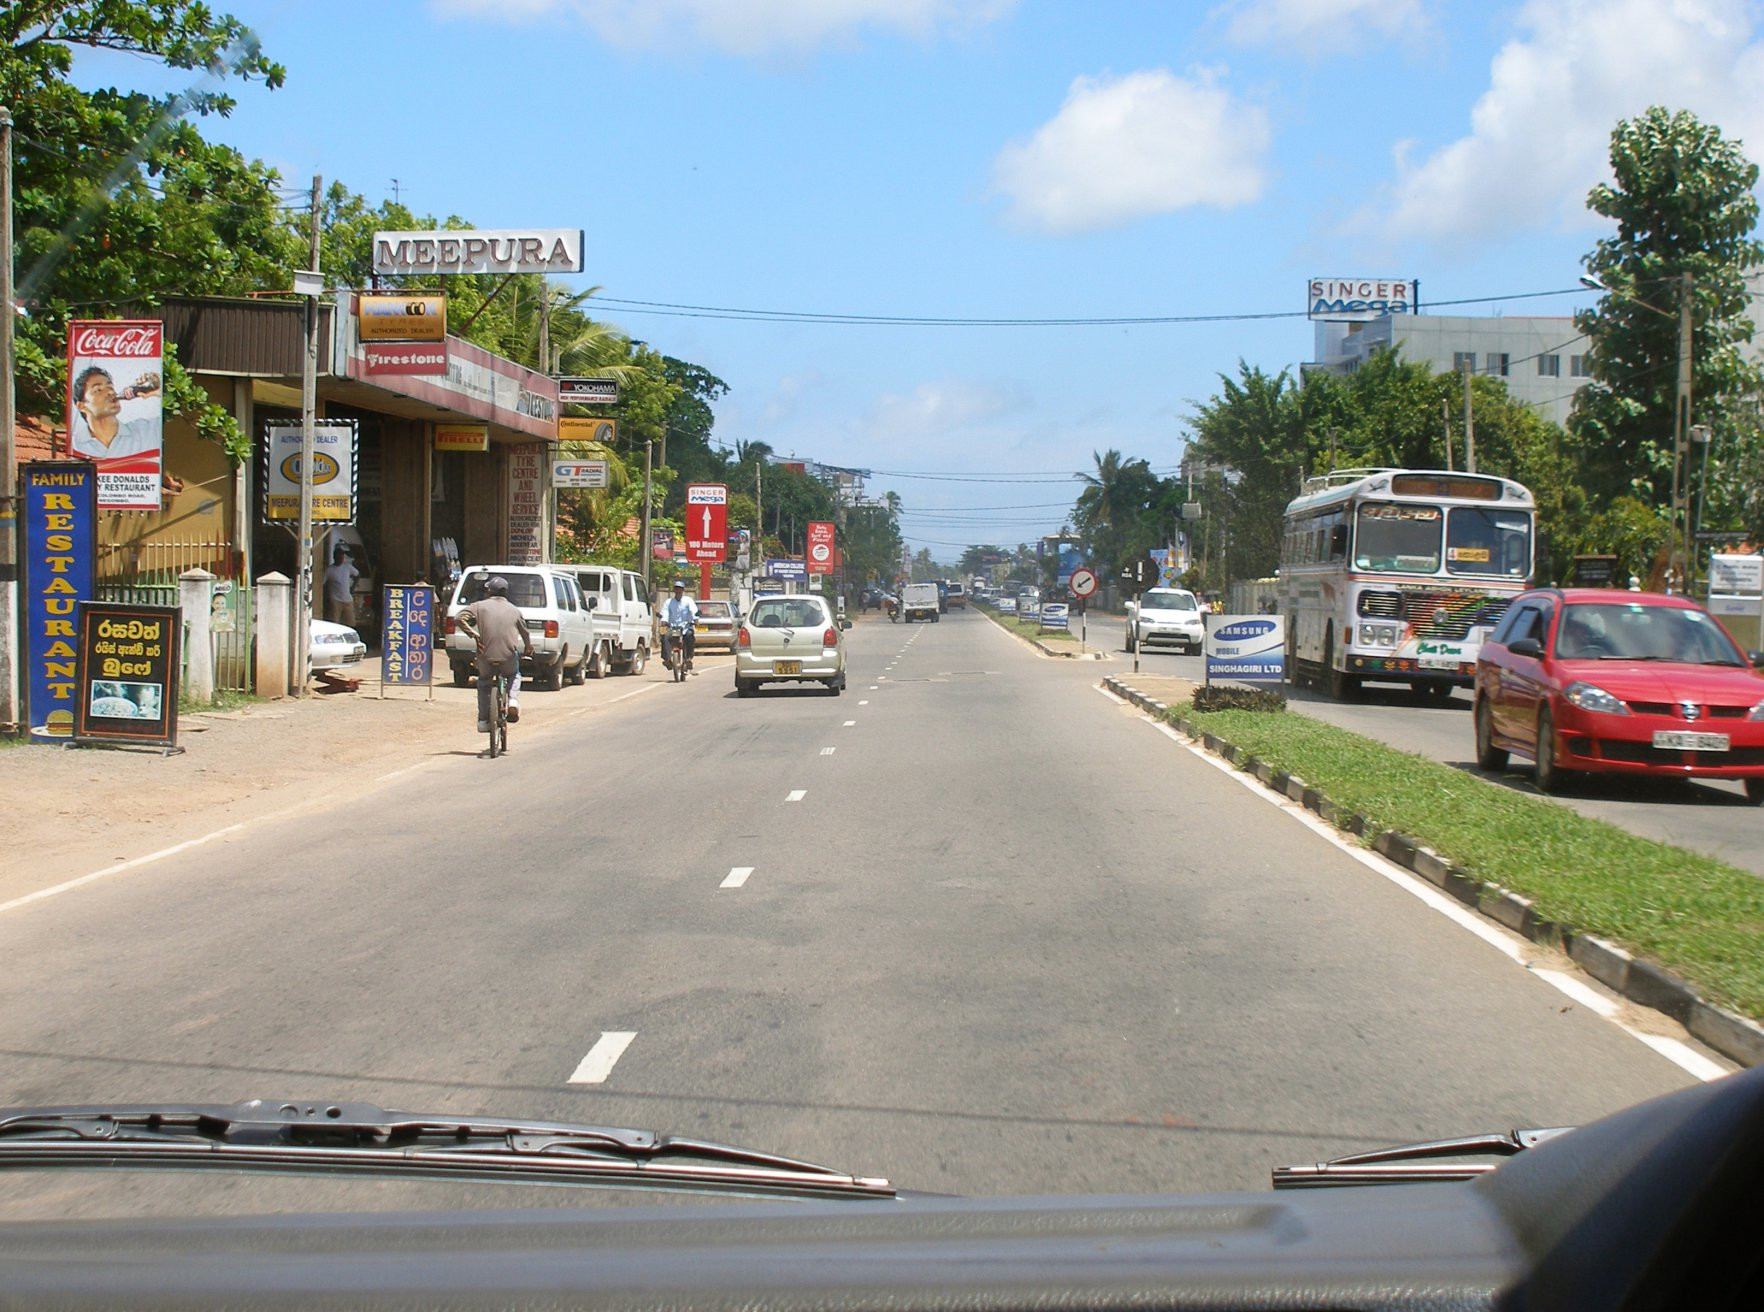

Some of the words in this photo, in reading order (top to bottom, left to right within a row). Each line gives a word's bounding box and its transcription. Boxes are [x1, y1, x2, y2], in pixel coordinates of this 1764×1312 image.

[378, 237, 573, 266] MEEPURA
[1311, 282, 1406, 298] SINGER
[76, 328, 159, 355] Coca-Cola
[367, 353, 445, 368] Firestone
[574, 384, 616, 393] YOKOHAMA
[560, 420, 593, 428] Continental
[316, 436, 338, 444] DEALER
[516, 455, 536, 467] TYRE
[512, 467, 539, 479] CENTRE
[31, 473, 86, 486] FAMILY
[113, 475, 150, 483] DONALDS
[518, 480, 534, 490] AND
[513, 491, 537, 503] WHEEL
[322, 499, 349, 508] CENTRE
[511, 503, 540, 514] SERVICE
[689, 541, 701, 549] 100
[696, 550, 717, 558] Ahead
[42, 493, 78, 699] RESTAURANT
[387, 588, 404, 682] BREAKFAST
[1220, 627, 1269, 635] SAMSUNG
[1209, 665, 1262, 673] SINGHAGIRI
[1264, 665, 1282, 673] LTD
